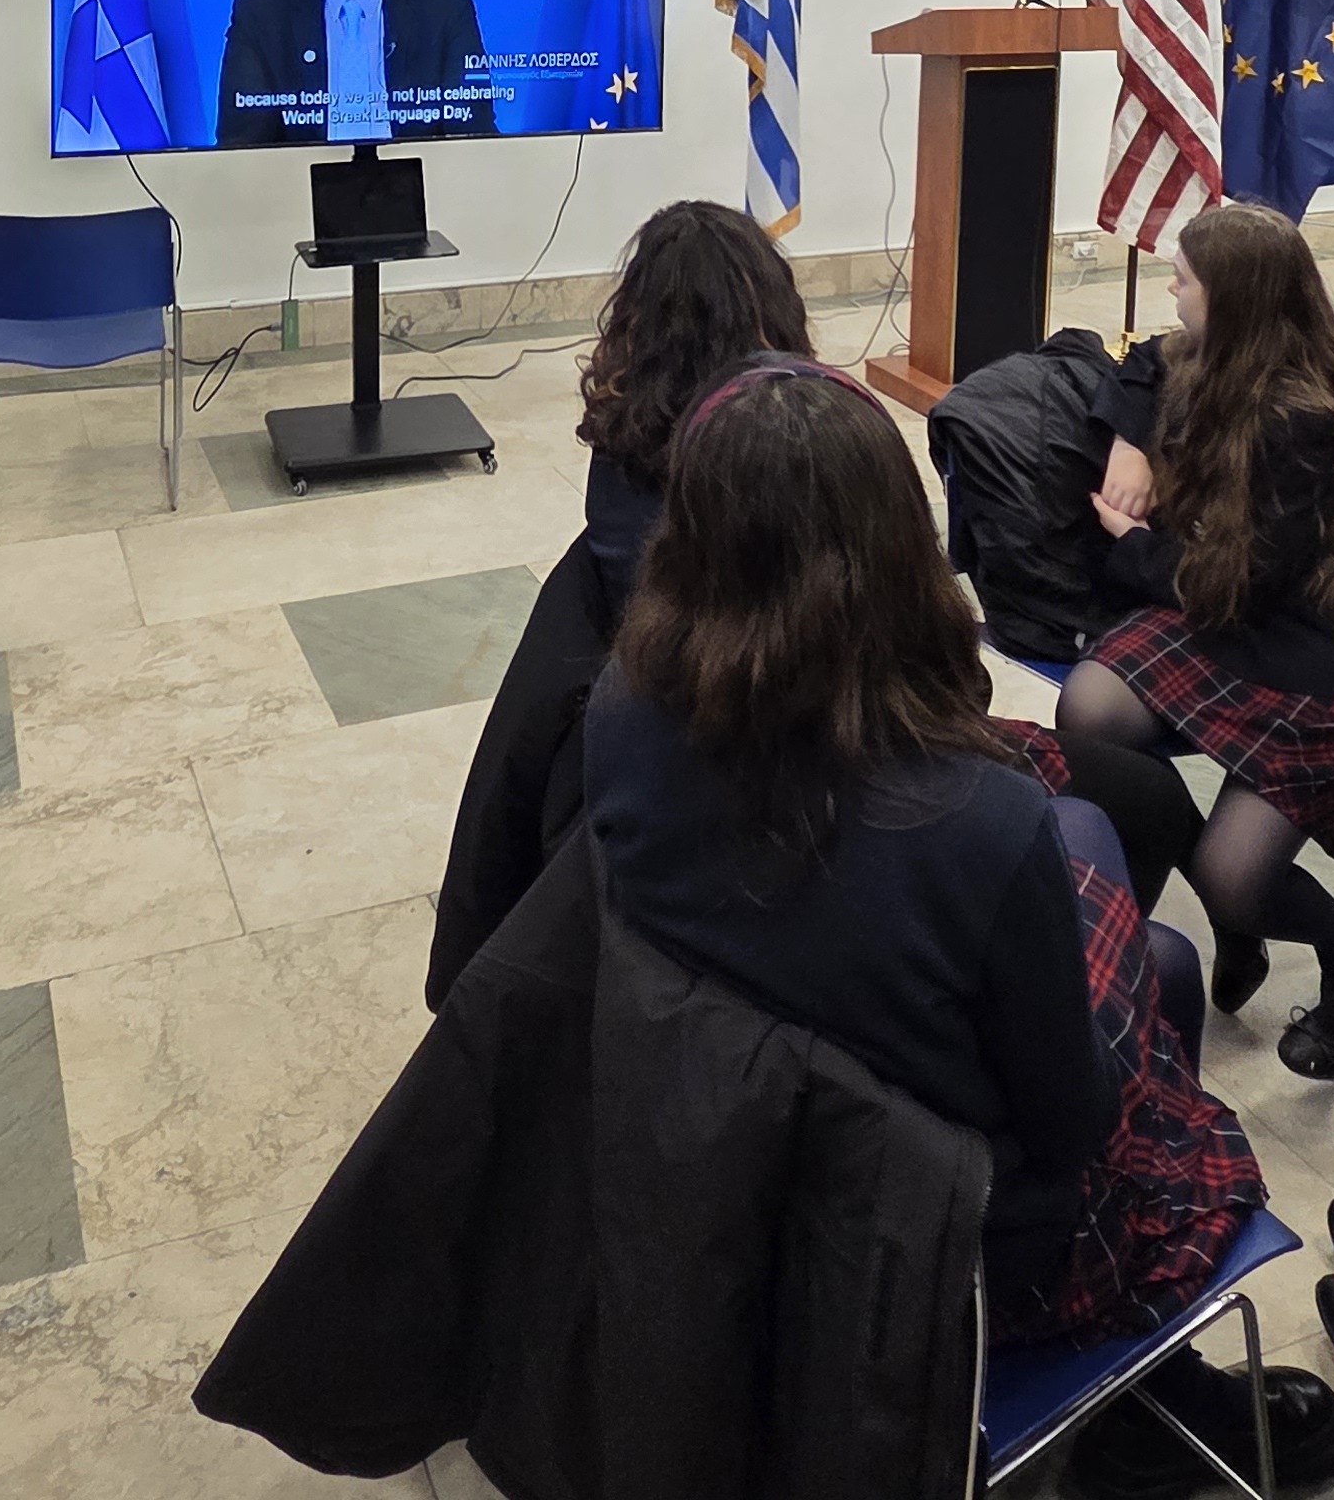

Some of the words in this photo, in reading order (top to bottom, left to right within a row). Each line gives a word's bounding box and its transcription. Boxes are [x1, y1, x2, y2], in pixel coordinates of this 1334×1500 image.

[464, 53, 527, 69] ΙΩΑΝΝΗΣ
[529, 51, 599, 68] ΛΟΒΕΡΔΟΣ
[235, 91, 297, 108] because
[300, 89, 339, 106] today
[344, 93, 364, 104] we
[367, 92, 389, 104] are
[392, 87, 415, 102] not
[415, 86, 442, 105] just
[443, 85, 515, 101] celebrating
[281, 108, 324, 125] World
[330, 108, 371, 123] Greek
[373, 107, 441, 125] Language
[443, 104, 473, 122] Day.
